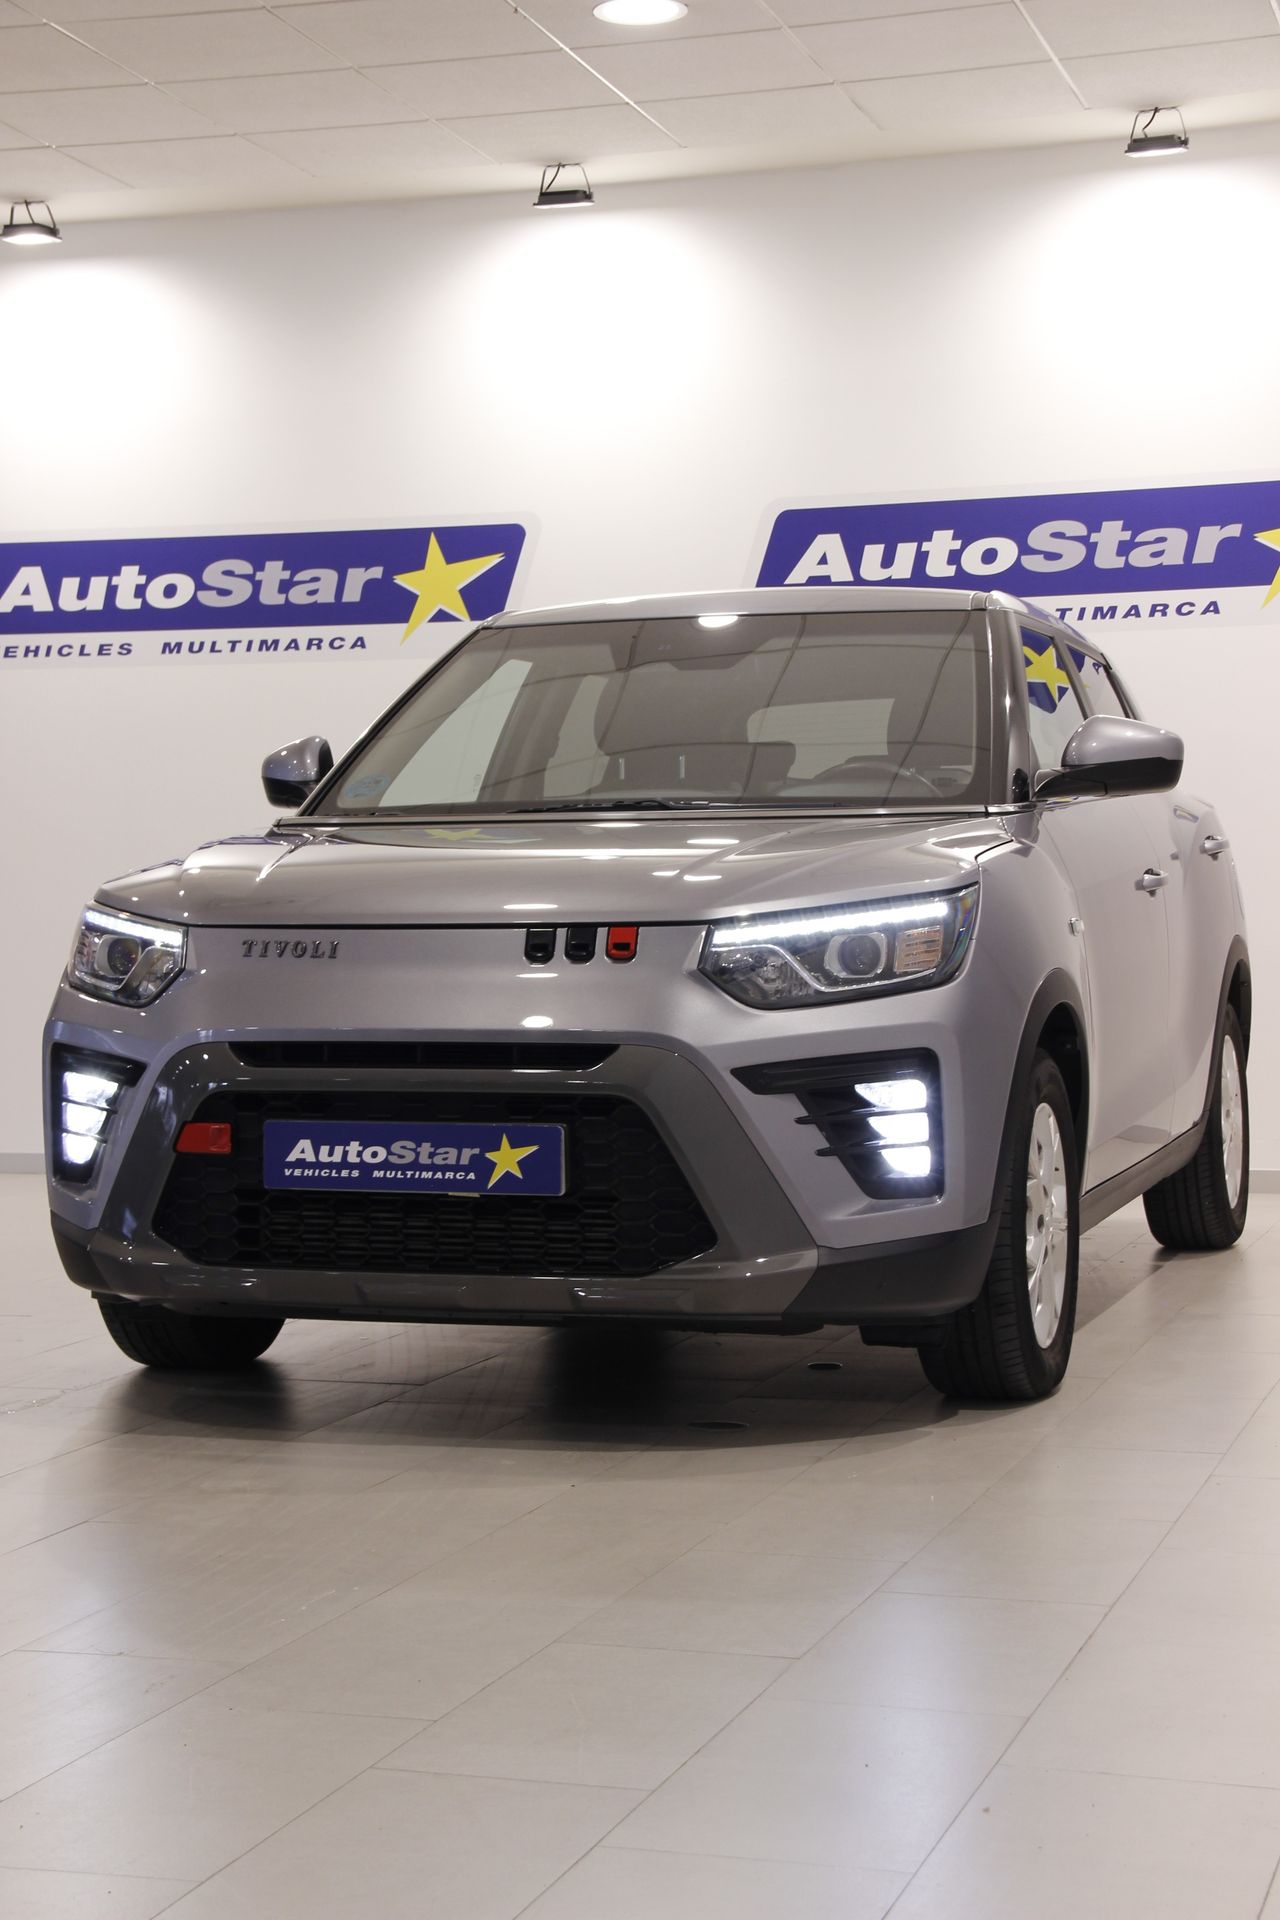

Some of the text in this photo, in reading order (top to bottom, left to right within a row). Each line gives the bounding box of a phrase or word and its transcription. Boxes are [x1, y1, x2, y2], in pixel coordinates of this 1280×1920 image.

[784, 519, 1243, 585] AutoStar
[0, 559, 384, 614] AutoStar
[1055, 600, 1221, 622] TIMARCA
[0, 636, 368, 658] EHICLES MULTIMARCA
[242, 939, 341, 959] TIVOLI
[285, 1139, 480, 1165] AutoStar
[284, 1168, 476, 1180] VEHICLES MULTIMARCA
